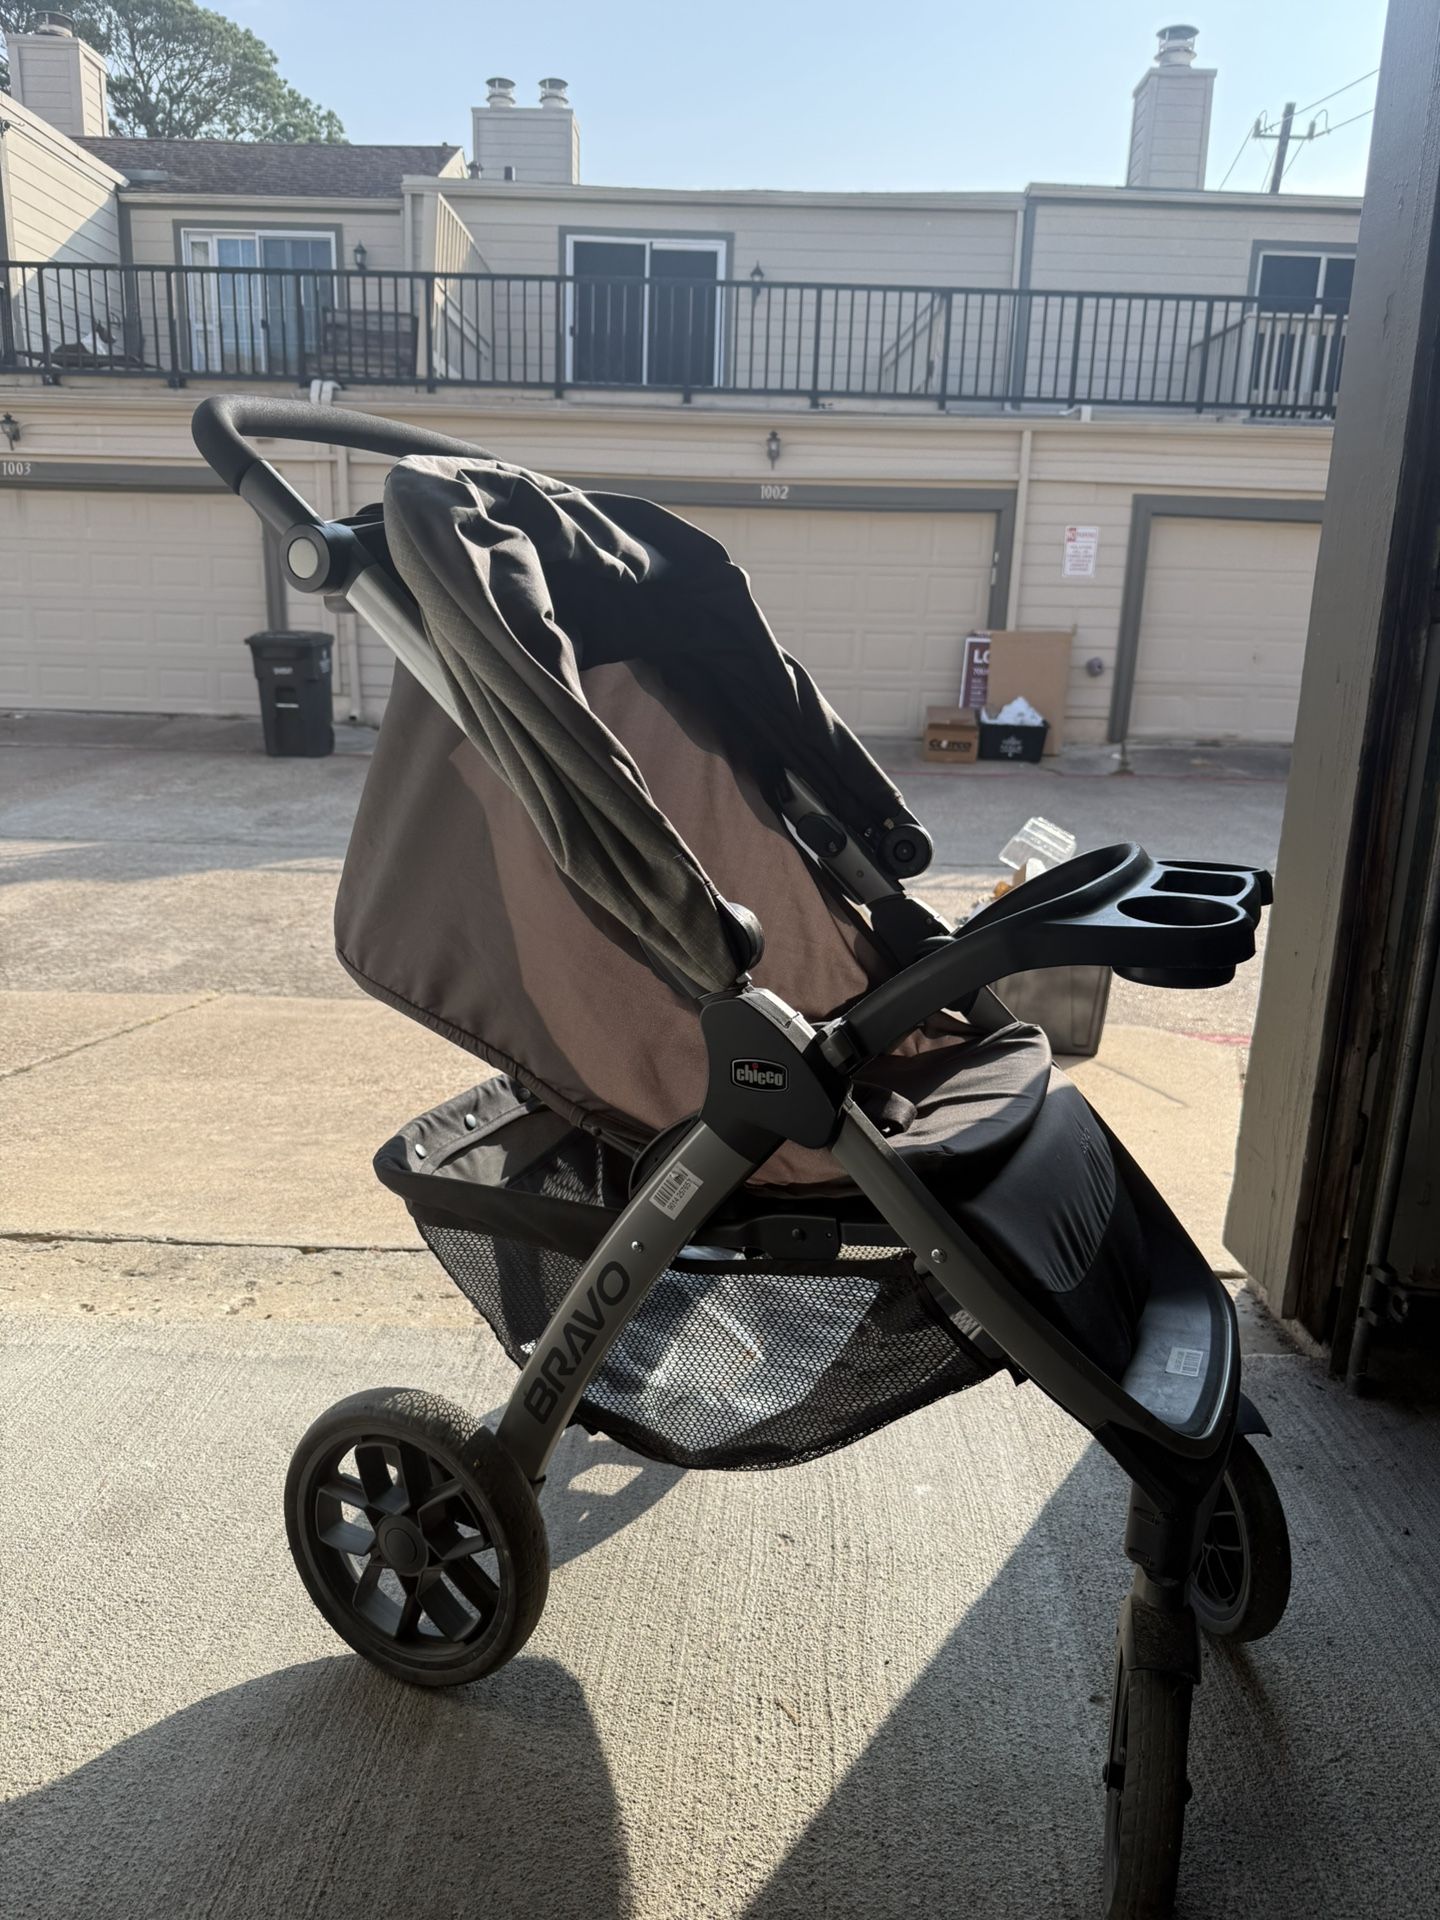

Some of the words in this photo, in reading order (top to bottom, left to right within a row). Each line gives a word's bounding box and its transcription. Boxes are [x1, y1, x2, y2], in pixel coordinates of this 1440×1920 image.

[3, 462, 31, 476] 1003
[761, 485, 789, 499] 1002
[736, 1063, 783, 1087] chicco
[524, 1261, 630, 1425] BRAVO
